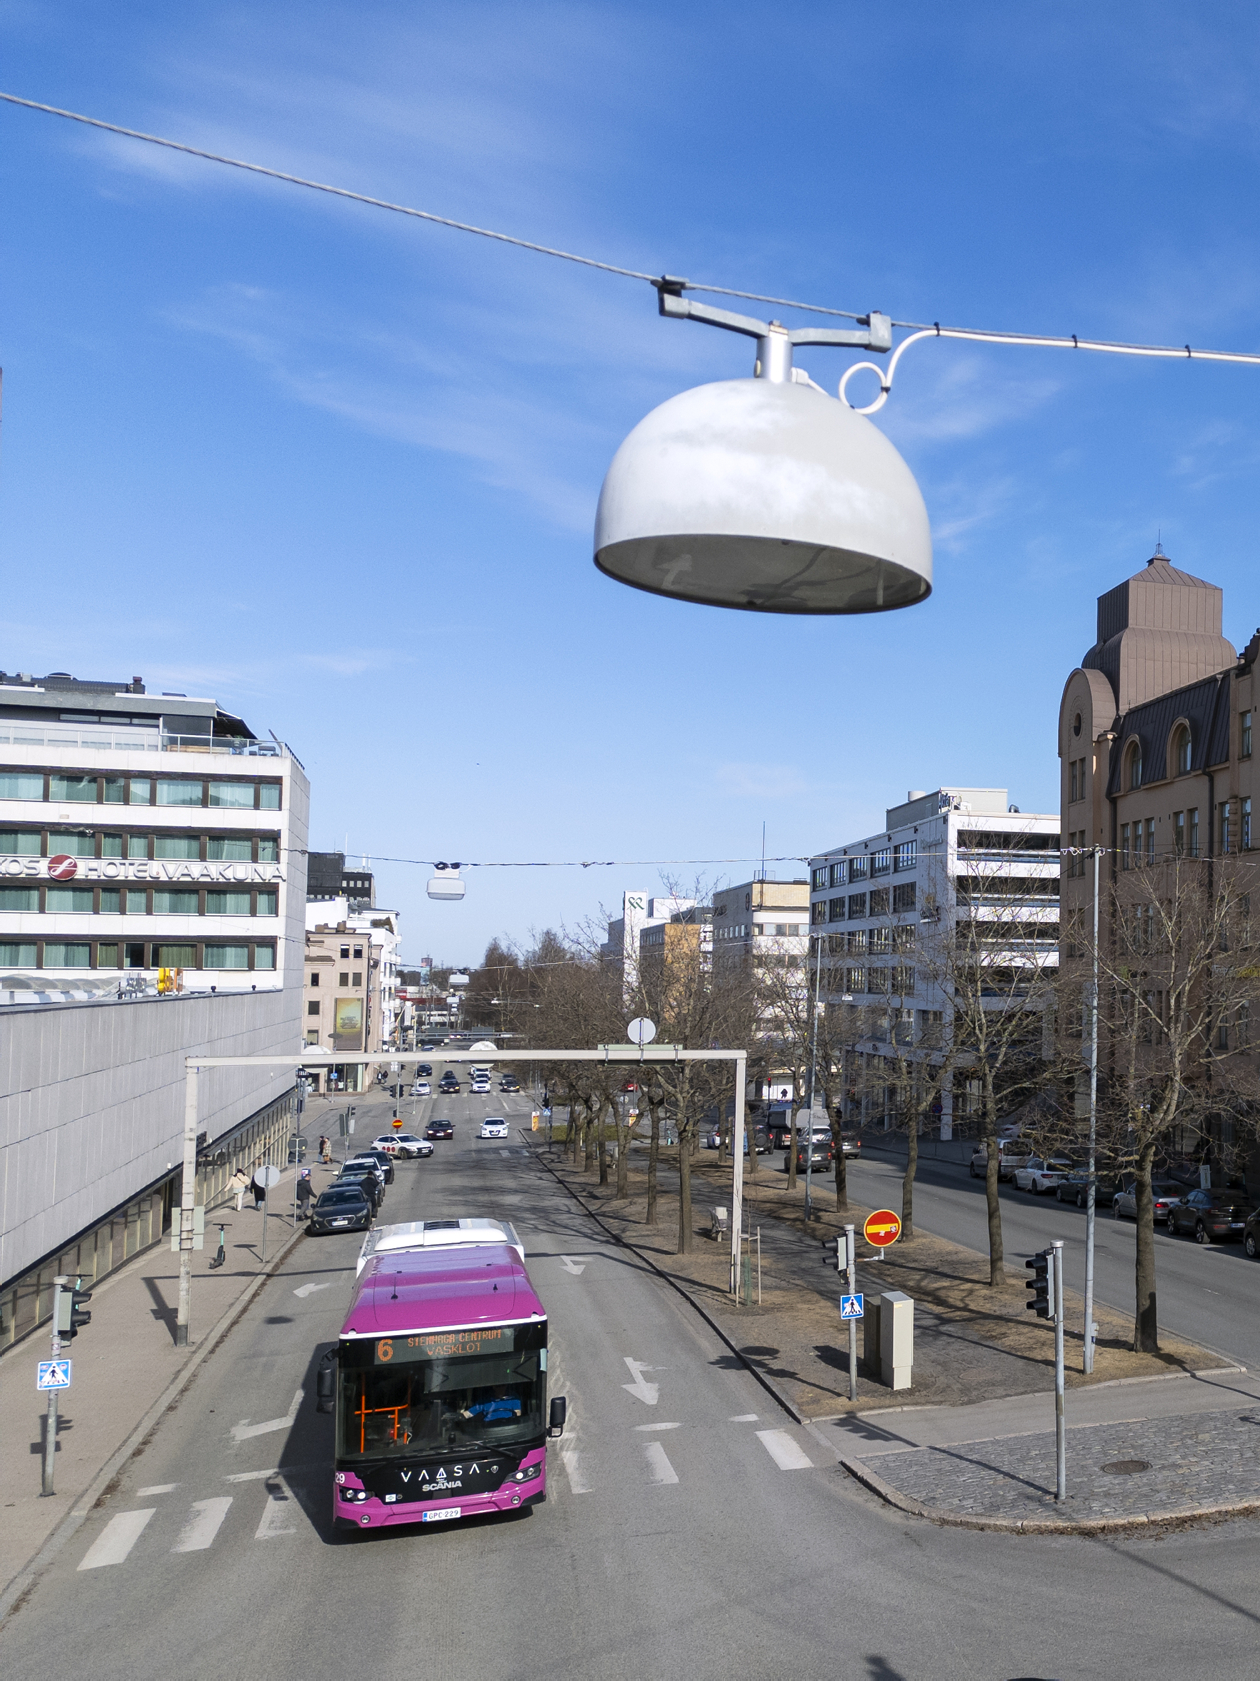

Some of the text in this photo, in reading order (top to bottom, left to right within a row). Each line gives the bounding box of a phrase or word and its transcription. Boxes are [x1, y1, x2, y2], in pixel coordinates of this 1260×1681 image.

[84, 860, 287, 882] HOTEL VAAKUNA
[377, 1338, 394, 1362] 6
[426, 1342, 481, 1356] VASKLOT
[421, 1479, 463, 1492] SCANIA
